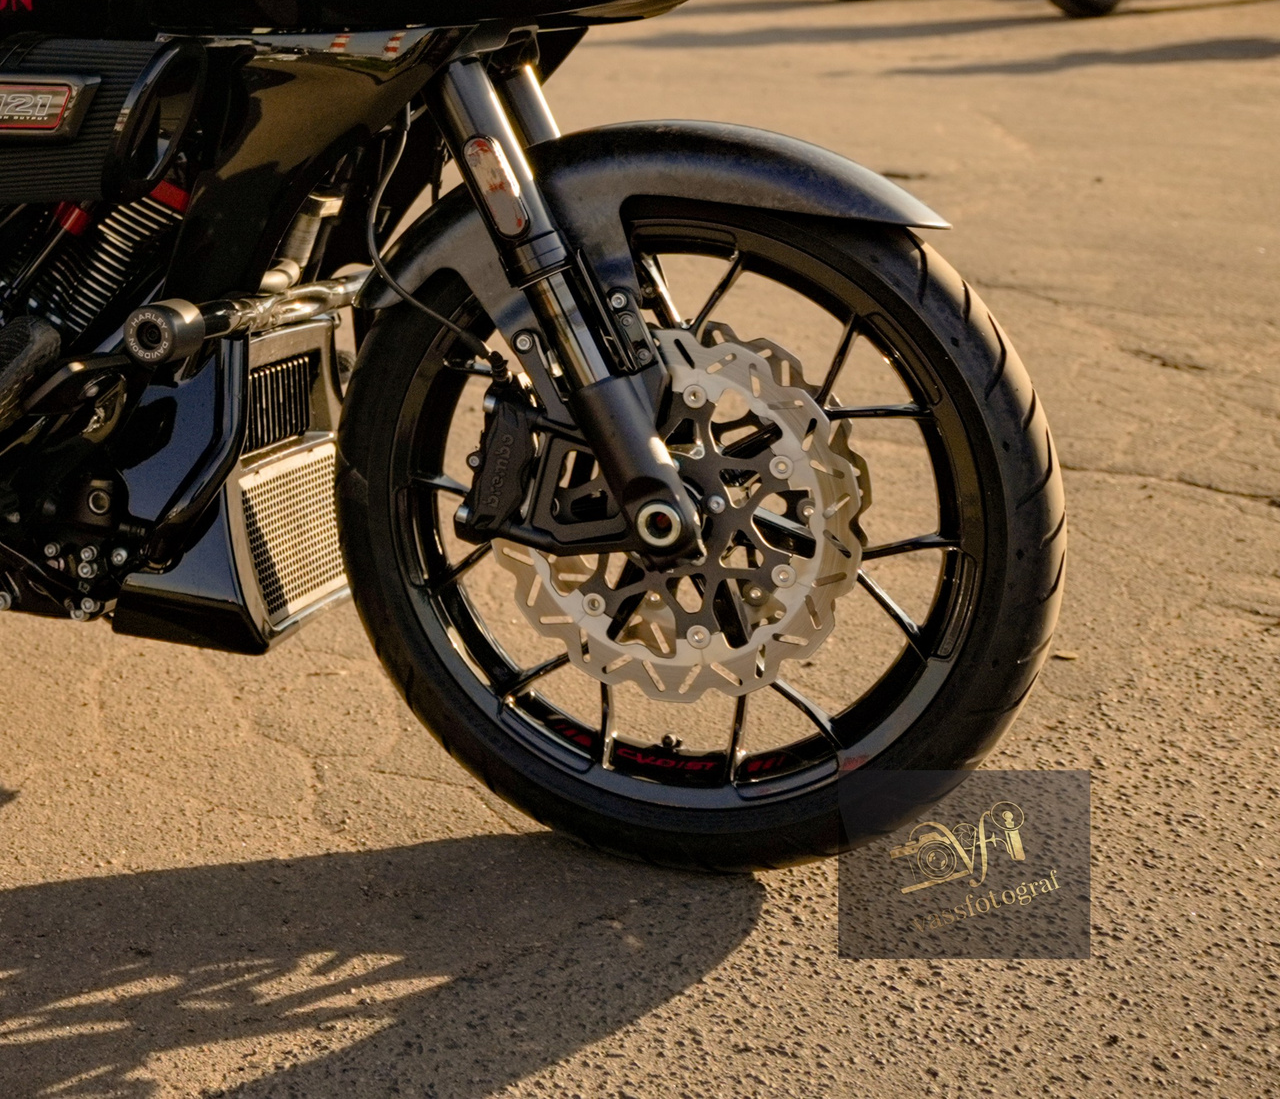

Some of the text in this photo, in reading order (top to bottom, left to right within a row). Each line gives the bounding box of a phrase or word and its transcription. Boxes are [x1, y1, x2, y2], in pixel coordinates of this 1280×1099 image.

[130, 312, 168, 329] HARLEY
[128, 337, 169, 359] DAVIDSON
[482, 433, 515, 507] brembo
